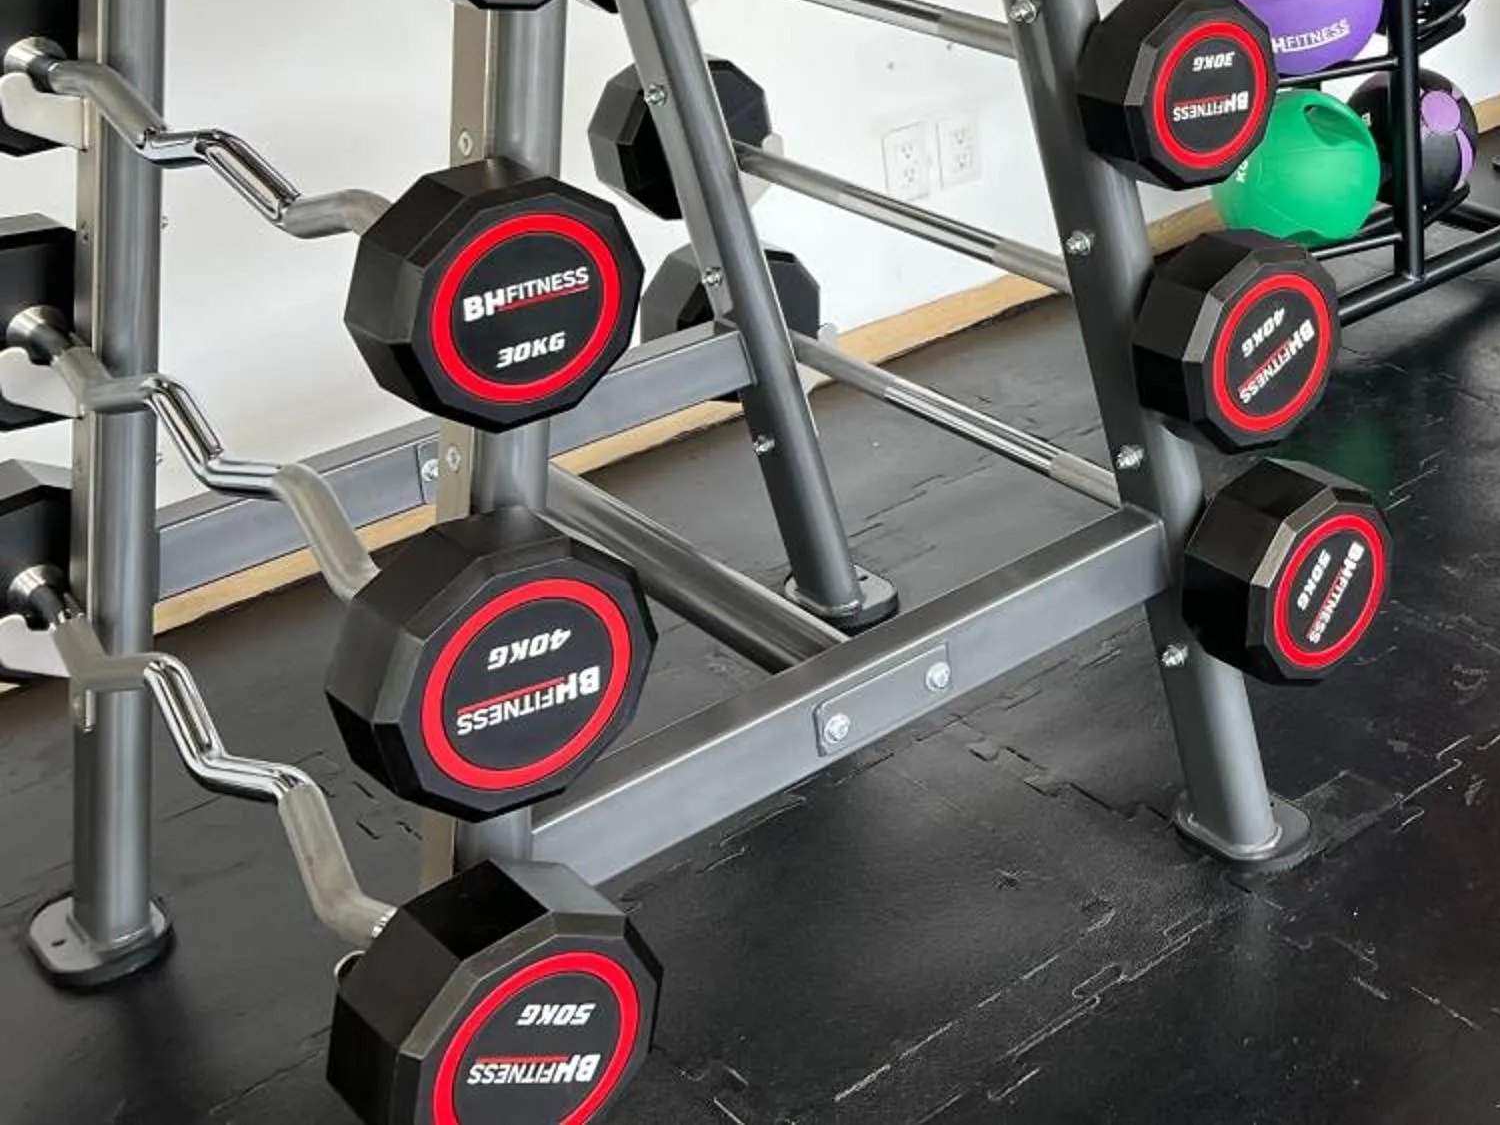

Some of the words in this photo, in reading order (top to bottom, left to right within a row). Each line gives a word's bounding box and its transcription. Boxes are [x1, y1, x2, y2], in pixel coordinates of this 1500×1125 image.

[1270, 18, 1351, 53] HFITNESS
[1191, 51, 1236, 73] 30KG
[496, 330, 566, 369] 30KG
[1241, 306, 1286, 359] 40KG
[1296, 547, 1332, 611] 50KG
[487, 628, 572, 671] 40KG
[517, 1002, 597, 1026] 50KG
